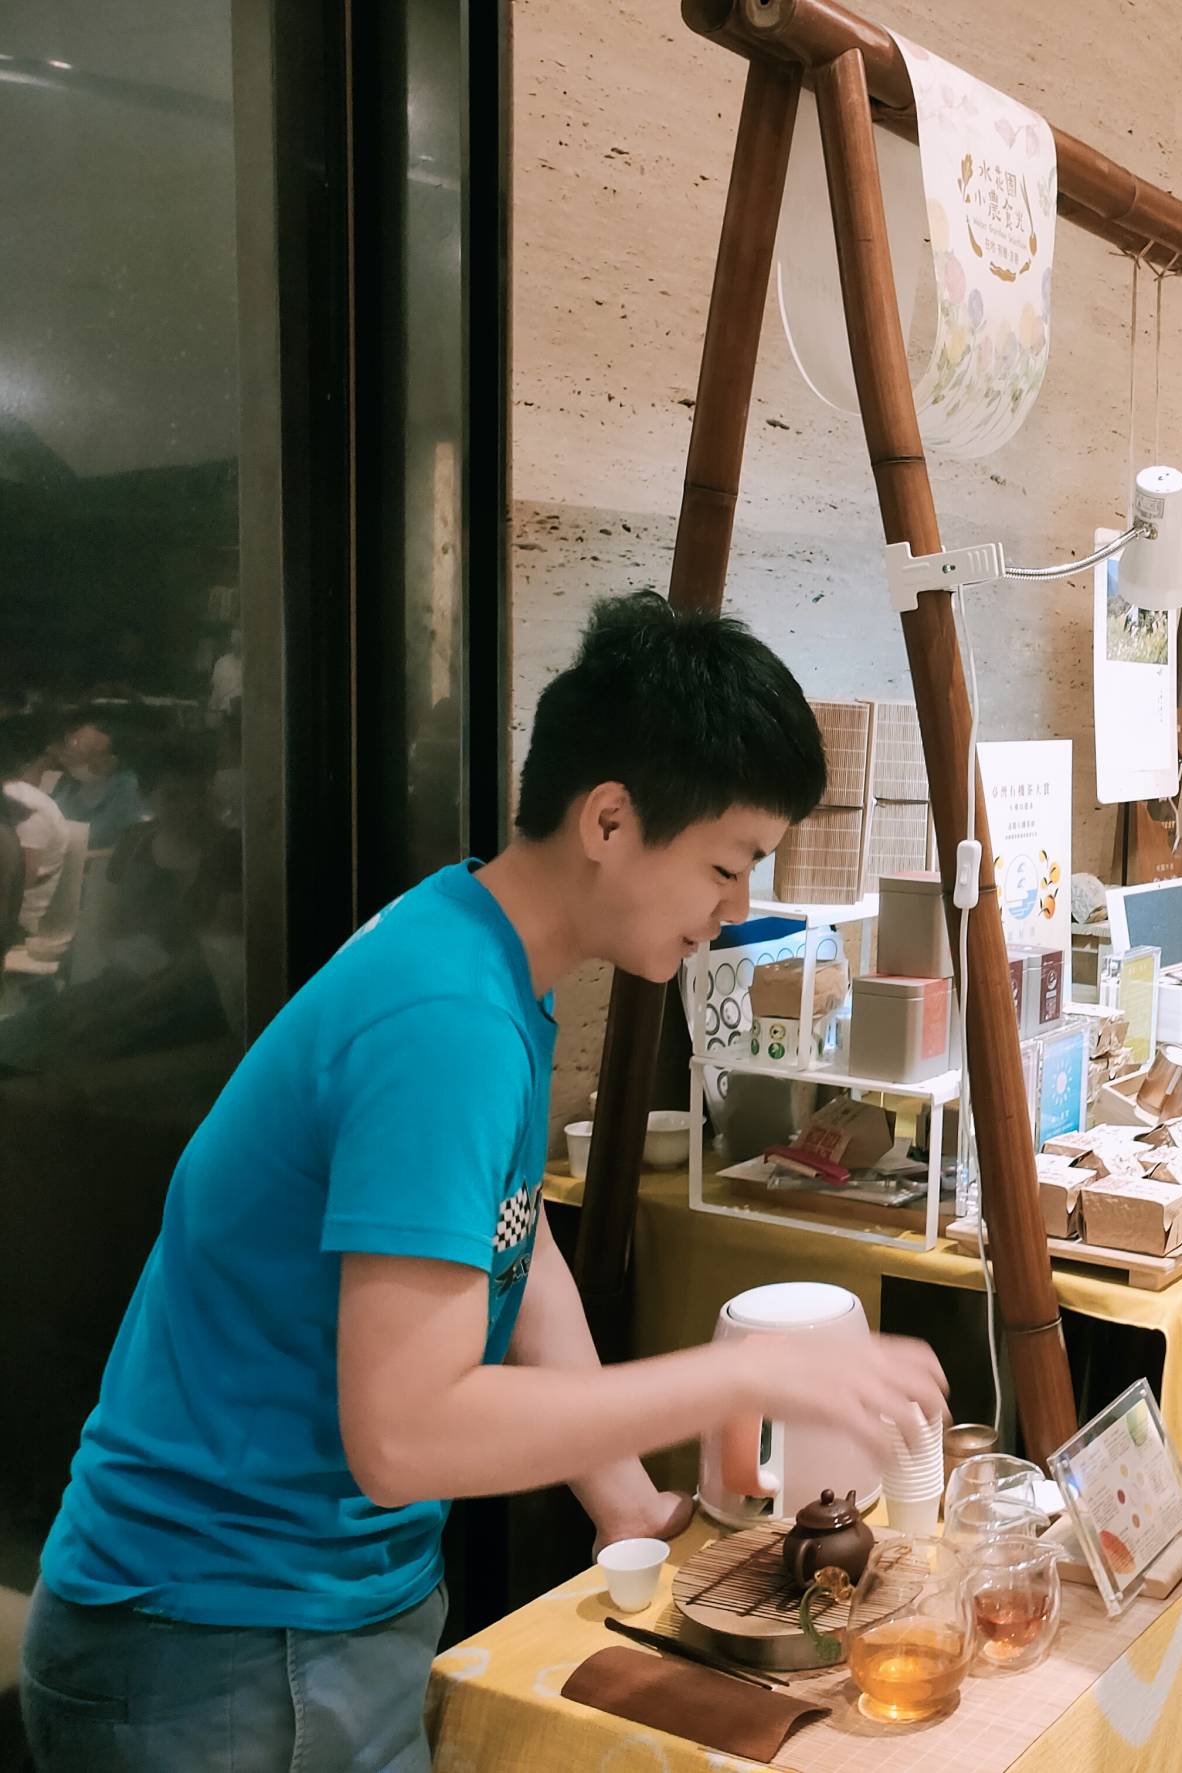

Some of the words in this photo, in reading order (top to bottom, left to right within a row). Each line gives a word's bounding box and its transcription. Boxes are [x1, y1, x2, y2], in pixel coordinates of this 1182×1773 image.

[978, 159, 1017, 198] 水花園
[974, 188, 1025, 233] 小農食光
